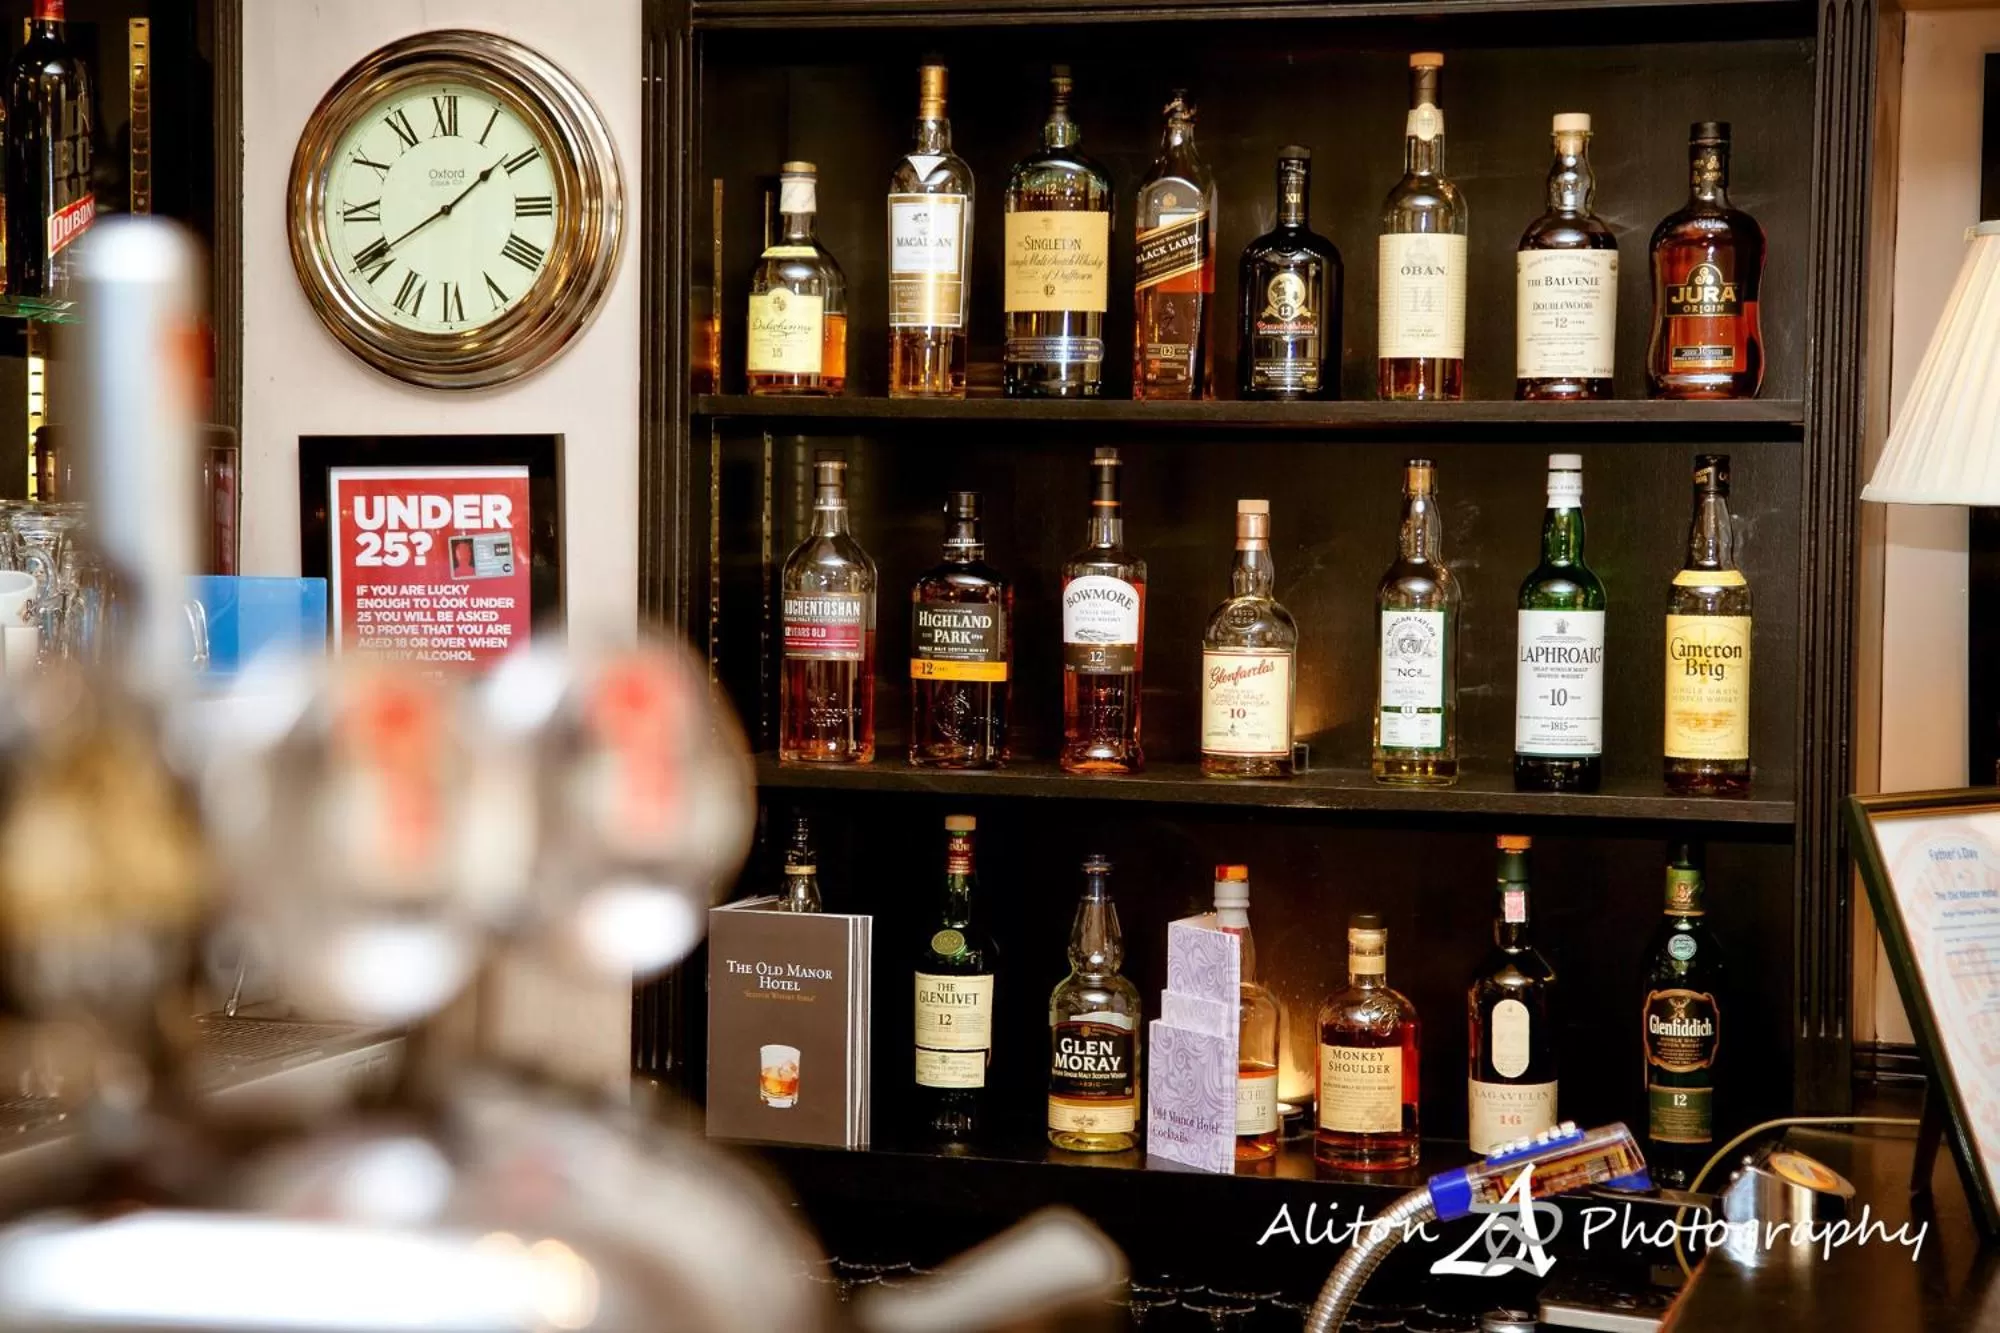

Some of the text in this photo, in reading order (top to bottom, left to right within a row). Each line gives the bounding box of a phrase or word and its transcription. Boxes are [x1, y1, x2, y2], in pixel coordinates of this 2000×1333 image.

[429, 168, 465, 179] Oxford
[895, 236, 952, 247] MACALAN
[1024, 235, 1082, 251] SINGLETON
[1169, 234, 1201, 251] LABEL
[1400, 265, 1446, 276] OBAN
[1544, 275, 1601, 286] BALVENIE
[1410, 286, 1434, 313] 14
[1671, 286, 1736, 303] JURA
[1682, 304, 1725, 313] ORIGIN
[1554, 317, 1568, 329] 12
[354, 494, 513, 530] UNDER
[355, 531, 433, 567] 25?
[356, 584, 470, 595] IF YOU ARE LUCKY
[356, 597, 514, 609] ENOUGH TO LOOK UNDER
[1066, 588, 1134, 610] BOWMORE
[357, 611, 499, 622] 25 YOU WILL BE ASKED
[919, 611, 992, 629] HIGHLAND
[358, 624, 511, 635] TO PROVE THAT YOU ARE
[811, 627, 826, 638] OLD
[358, 637, 508, 648] AGED 18 OR OVER WHEN
[933, 629, 971, 645] PARK
[1670, 636, 1742, 660] Cameron
[416, 650, 475, 661] ALCOHOL
[1090, 651, 1104, 662] 12
[1520, 646, 1601, 664] LAPHROAIG
[921, 662, 933, 675] 12
[1686, 658, 1725, 681] Brig
[1550, 688, 1568, 706] 10
[1230, 708, 1247, 719] 10
[1550, 721, 1569, 731] 1815
[726, 959, 833, 980] THE OLD MANOR
[759, 976, 801, 991] HOTEL
[937, 983, 956, 992] THE
[919, 991, 979, 1005] GLENLIVET
[938, 1014, 952, 1025] 12
[1649, 1013, 1713, 1037] Glenfiddich
[1060, 1037, 1113, 1056] GLEN
[1054, 1052, 1121, 1071] MORAY
[1332, 1049, 1385, 1062] MONKEY
[1328, 1060, 1391, 1074] SHOULDER
[1673, 1094, 1687, 1106] 12
